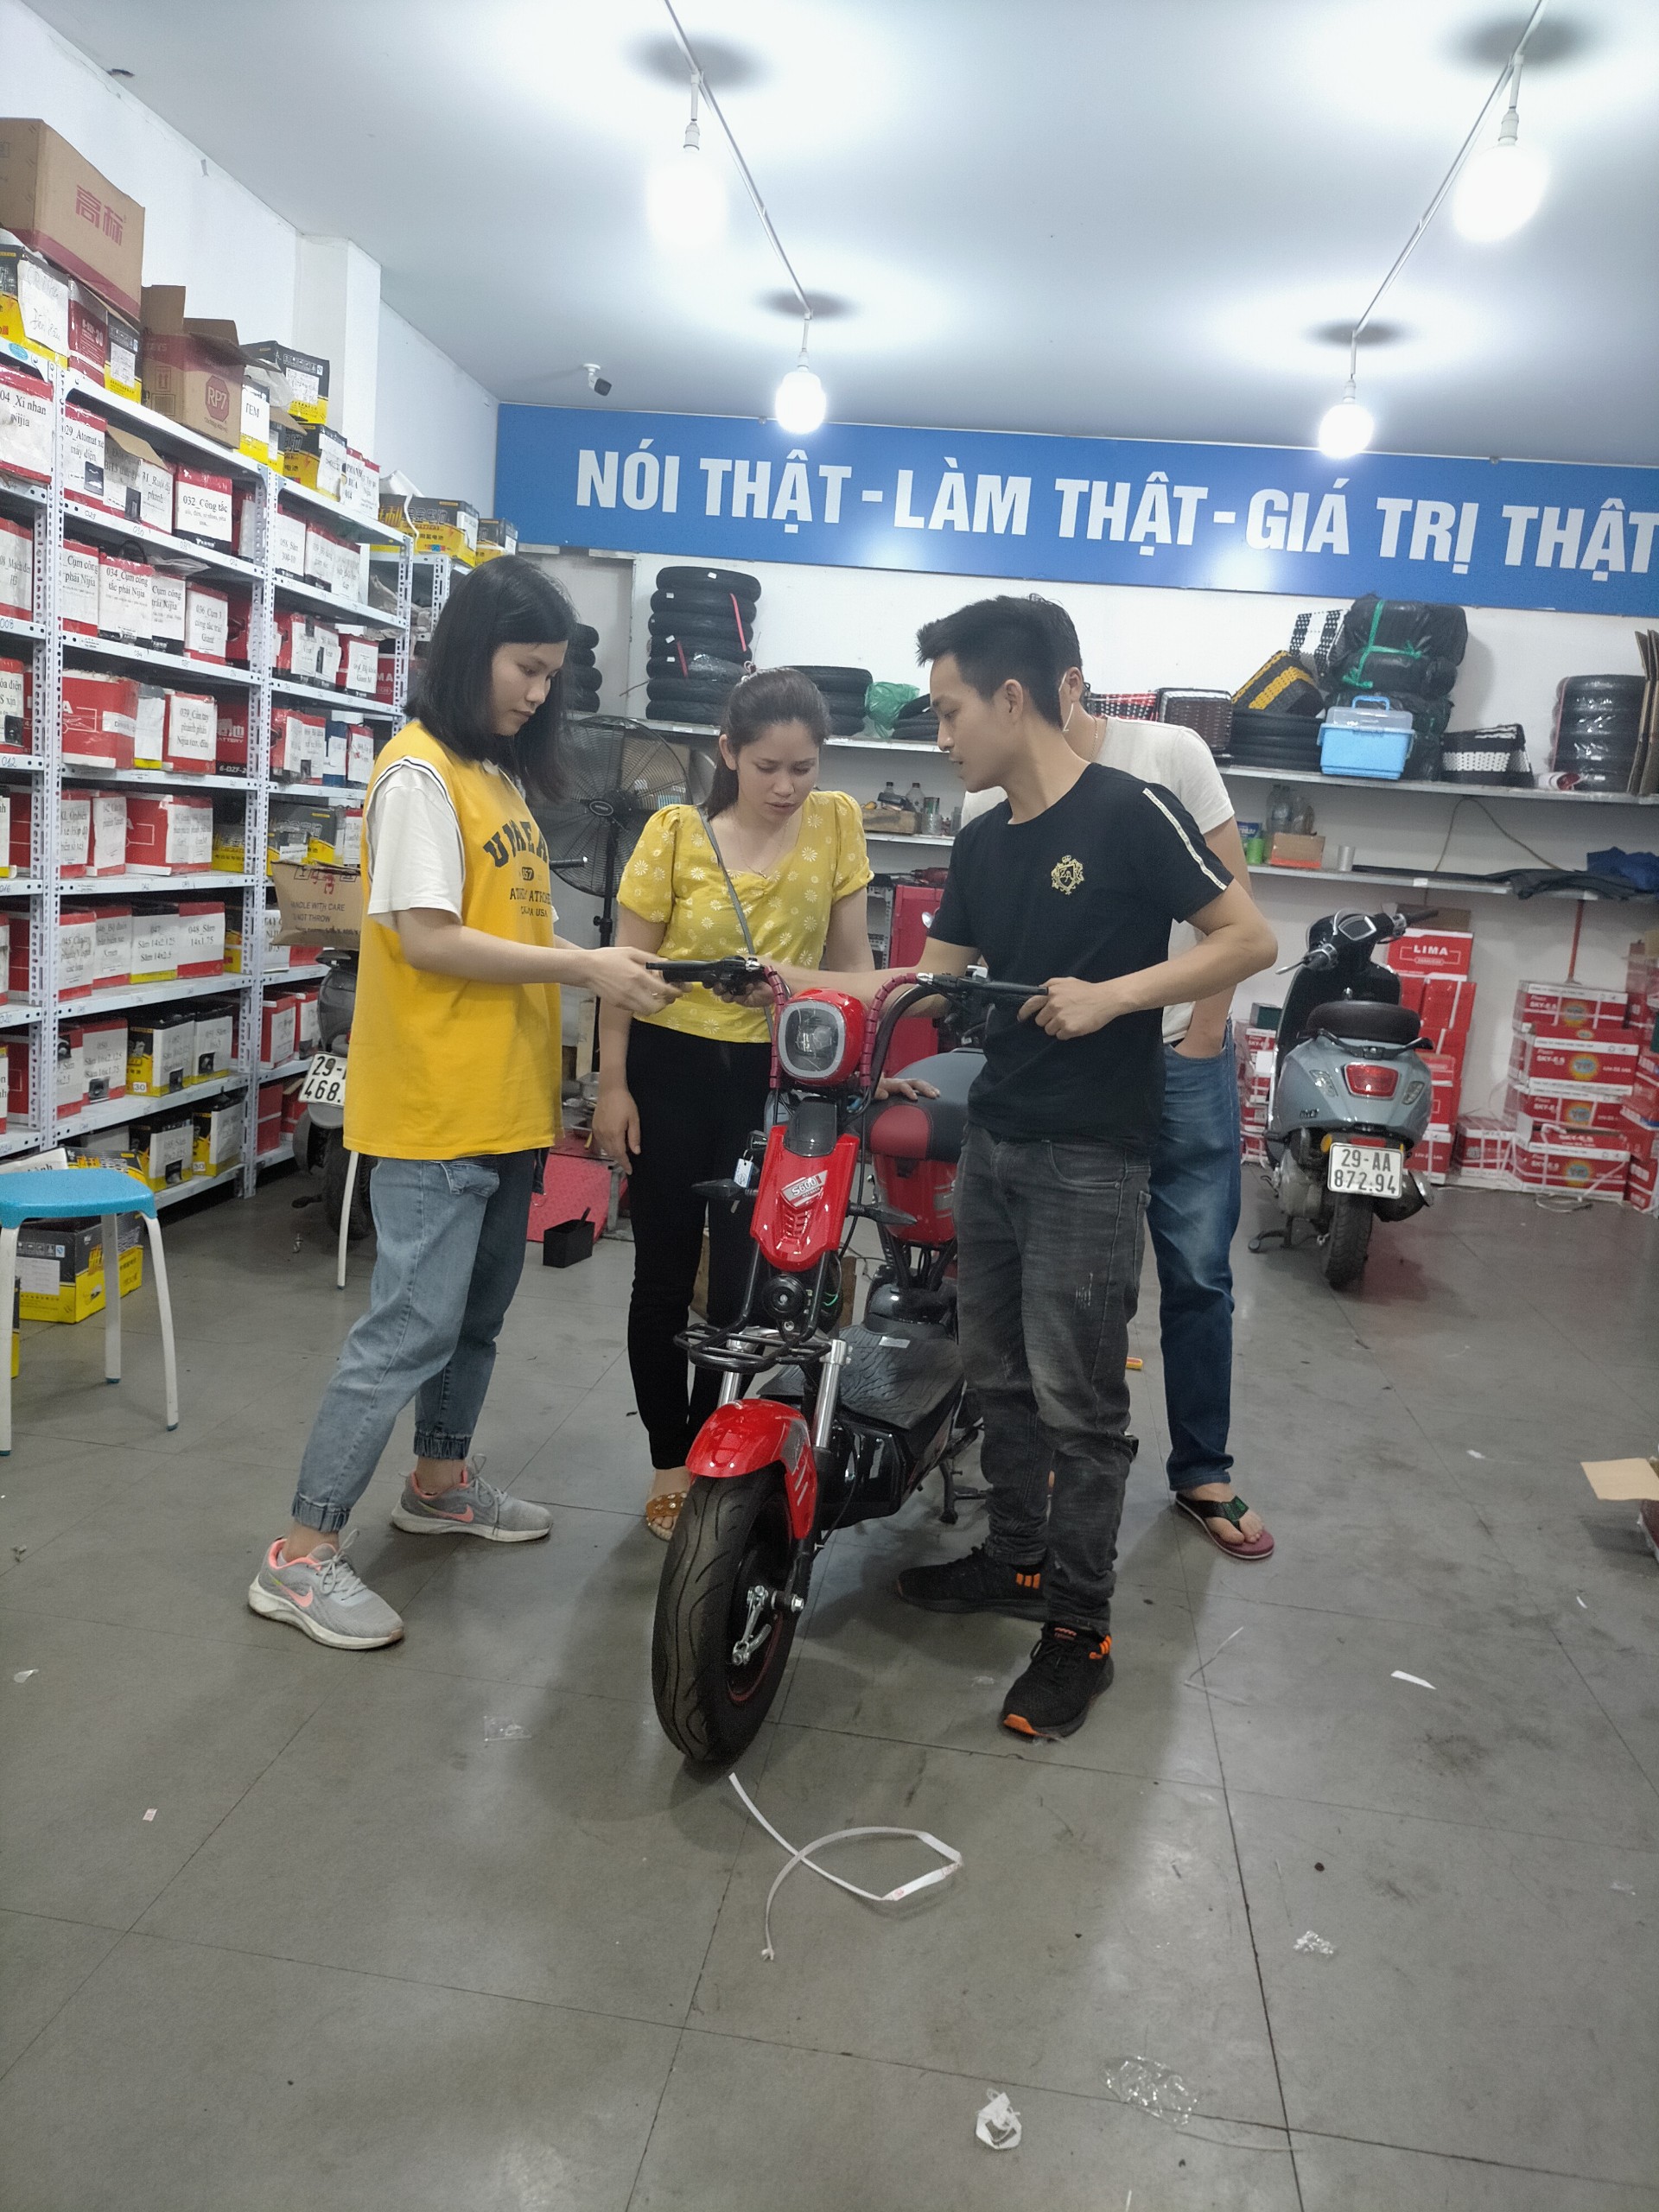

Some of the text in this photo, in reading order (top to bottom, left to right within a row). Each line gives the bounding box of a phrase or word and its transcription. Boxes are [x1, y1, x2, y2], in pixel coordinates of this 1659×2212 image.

[28, 401, 47, 416] nhan
[207, 386, 227, 410] RP7
[576, 438, 681, 513] NÓI
[699, 448, 853, 534] THẬT
[893, 456, 1032, 536] LÀM
[1055, 471, 1209, 556] THẬT
[1245, 477, 1351, 555] GIÁ
[1376, 497, 1480, 575] TRỊ
[1502, 498, 1659, 582] THẬT
[327, 903, 346, 912] CARE
[1413, 944, 1449, 957] LIMA
[1341, 1147, 1392, 1173] 29-AA
[791, 1176, 817, 1196] S600
[1333, 1169, 1397, 1195] 872.94
